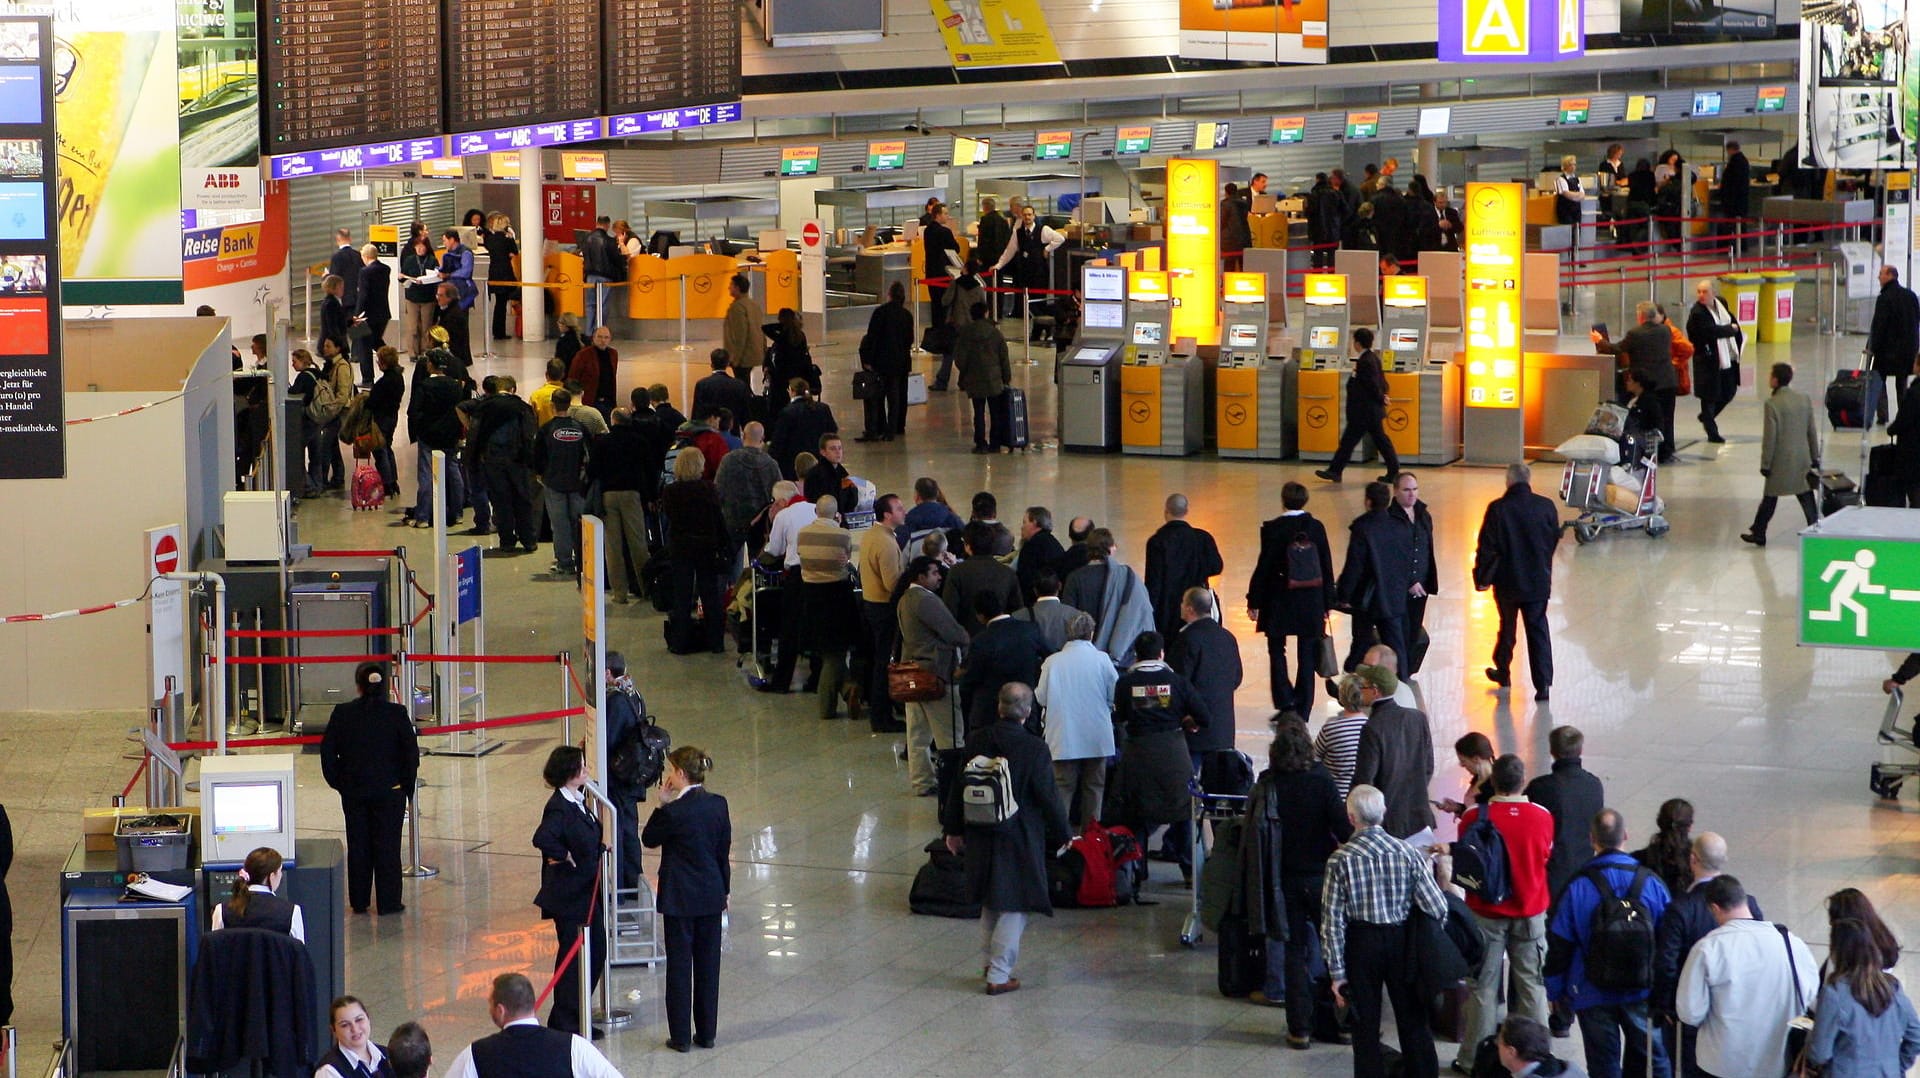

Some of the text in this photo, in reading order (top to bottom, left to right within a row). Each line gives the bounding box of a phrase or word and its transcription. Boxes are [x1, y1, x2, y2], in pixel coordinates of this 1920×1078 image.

[1471, 0, 1521, 48] A
[1560, 0, 1577, 47] A
[662, 111, 679, 128] ABC
[700, 108, 710, 123] DE
[511, 128, 531, 147] ABC
[554, 124, 566, 141] DE
[340, 148, 362, 168] ABC
[389, 143, 403, 162] DE
[204, 174, 240, 188] ABB
[1172, 200, 1212, 209] Lufthansa
[1472, 228, 1516, 236] Lufthansa
[184, 232, 254, 256] Reise Bank
[3, 380, 34, 390] Jetzt für
[5, 402, 33, 410] Handel
